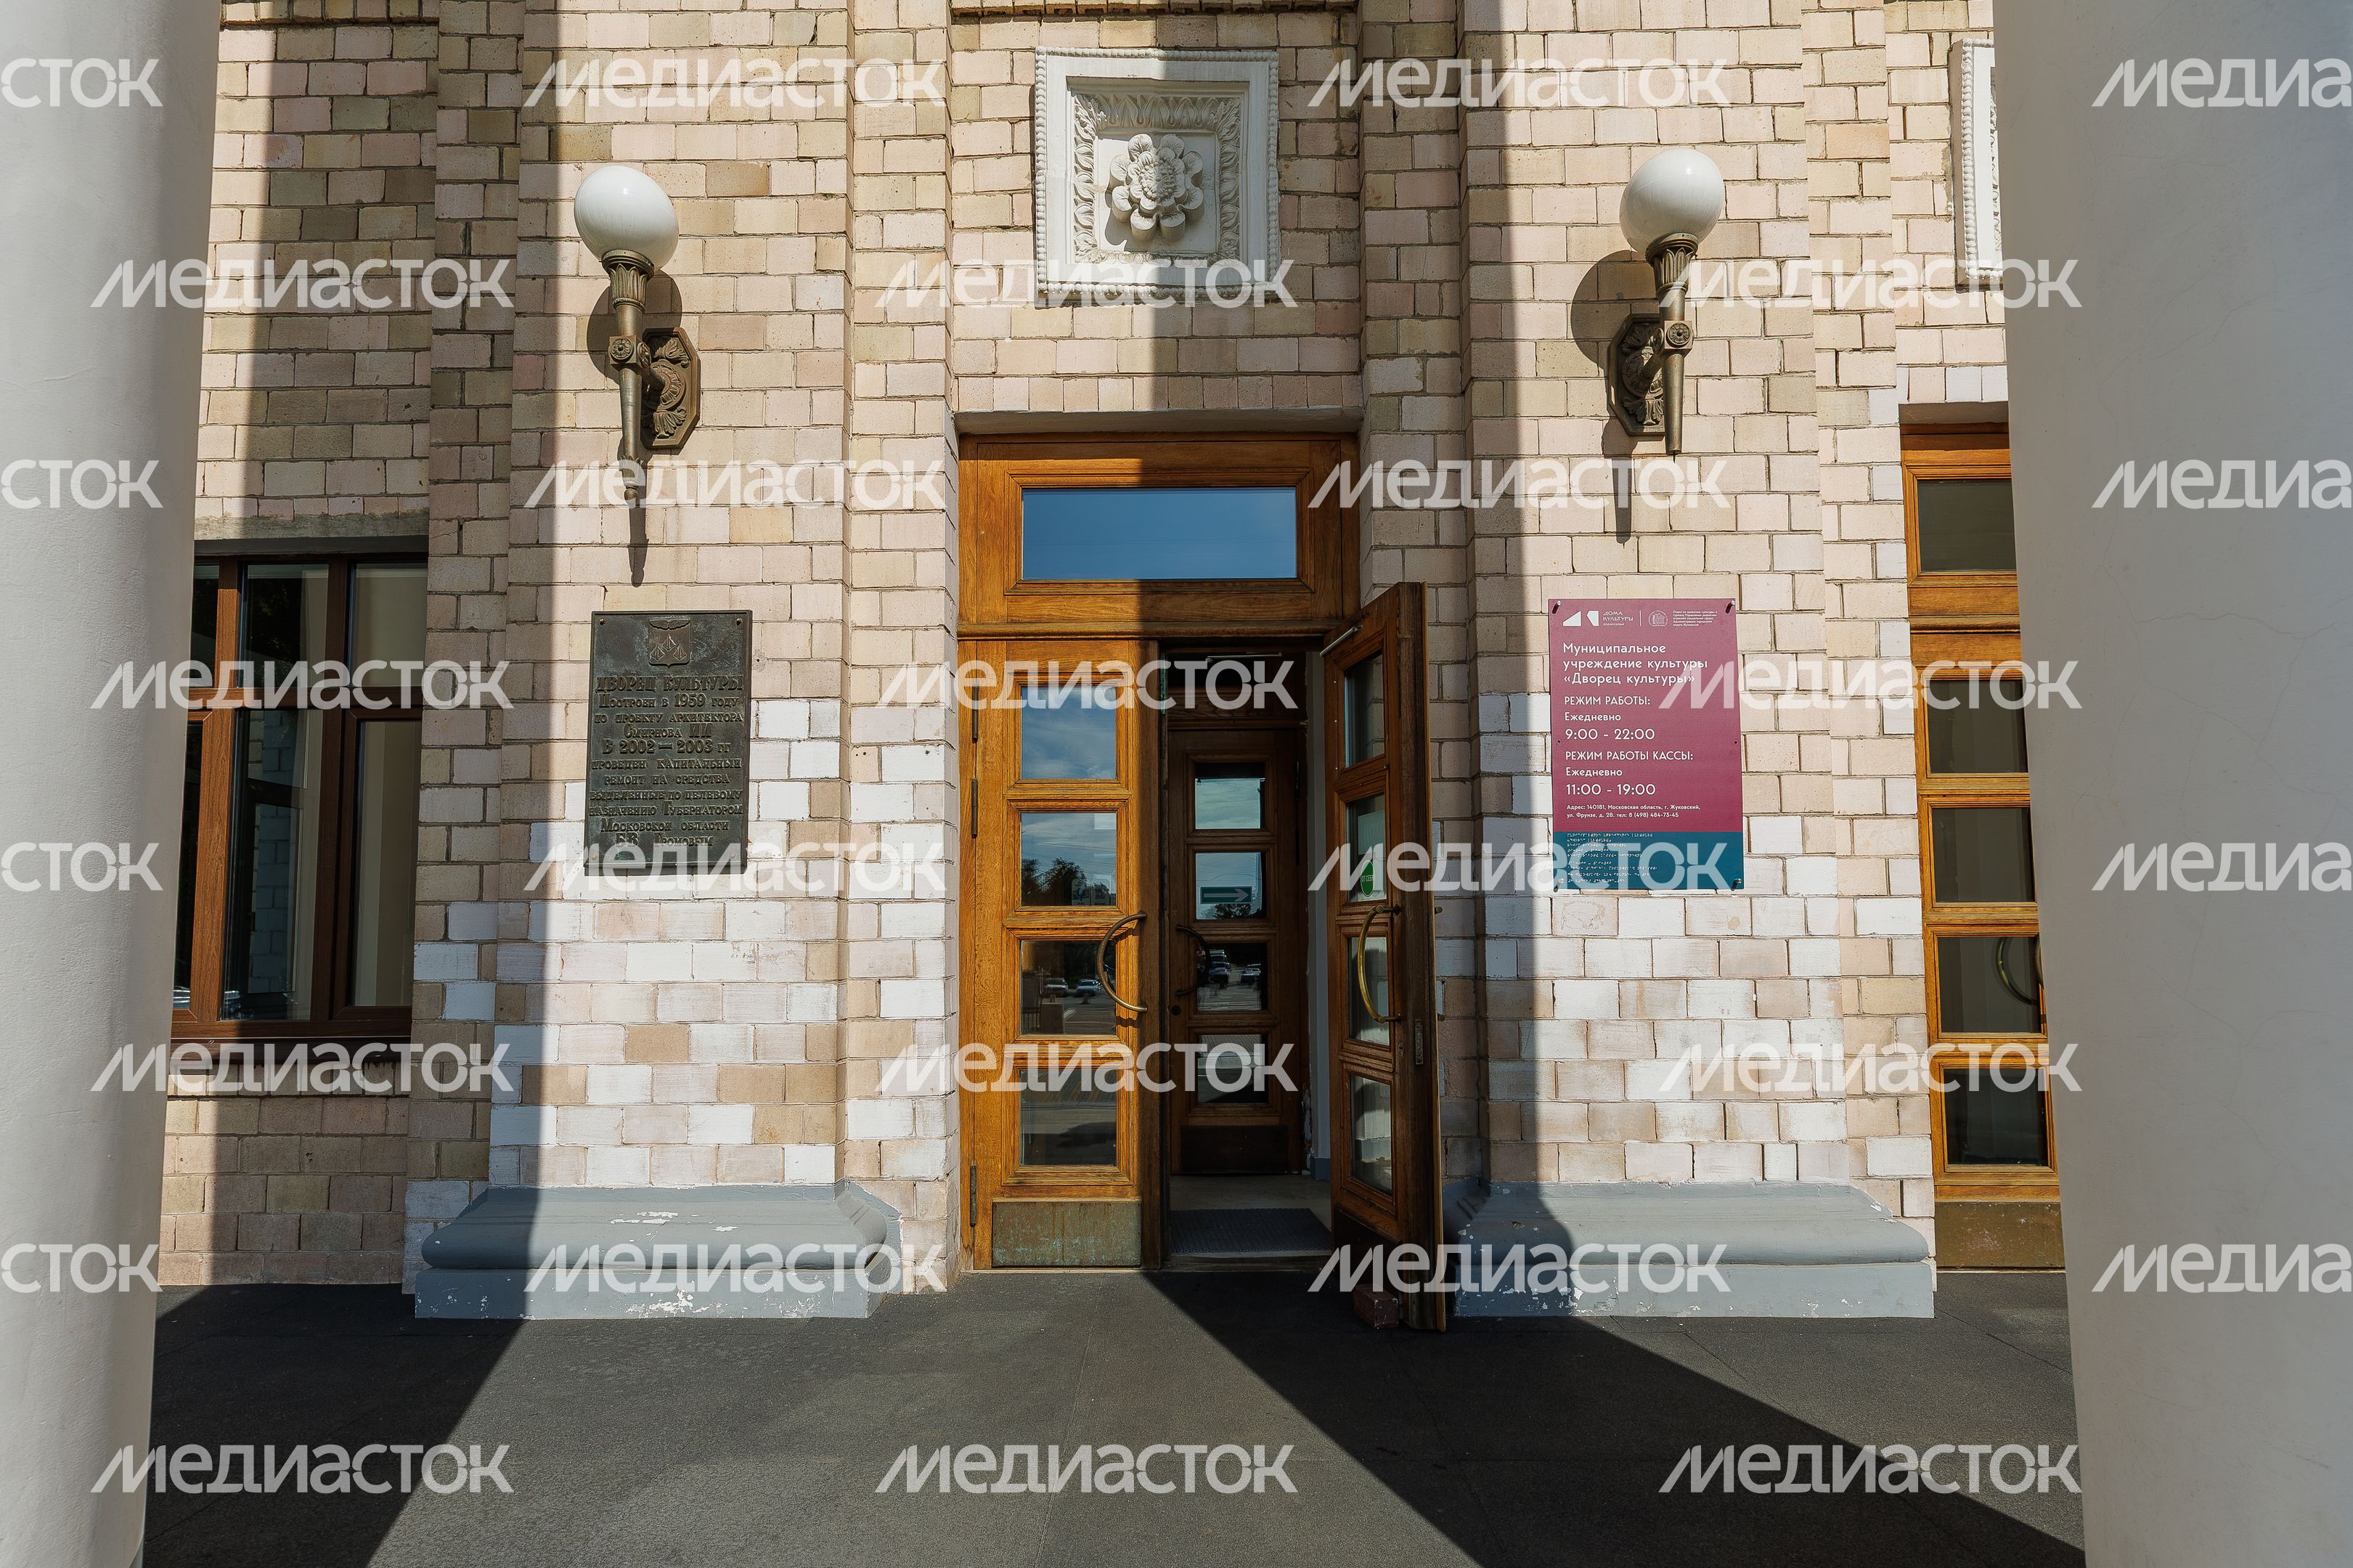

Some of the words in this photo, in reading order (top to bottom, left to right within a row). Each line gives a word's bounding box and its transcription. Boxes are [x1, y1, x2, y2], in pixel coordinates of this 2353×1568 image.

[1563, 642, 1666, 656] Муниципальное
[1563, 660, 1642, 671] учреждение
[1647, 660, 1708, 671] культуры
[595, 675, 657, 693] ДВОРЕЦ
[663, 675, 743, 690] КУЛЬТУРЫ
[1564, 672, 1621, 686] «Дворец
[1626, 676, 1695, 686] культуры»
[674, 693, 706, 708] 1959
[1565, 695, 1602, 705] РЕЖИМ
[1605, 695, 1650, 705] РАБОТЫ:
[615, 713, 664, 723] ПРОЕКТУ
[669, 712, 743, 722] АРХИТЕКТОРА
[1565, 712, 1621, 722] Ежедневно
[1565, 728, 1598, 740] 9:00
[1614, 728, 1655, 740] 22:00
[1566, 751, 1602, 760] РЕЖИМ
[1607, 751, 1649, 760] РАБОТЫ
[1652, 751, 1693, 760] КАССЫ:
[591, 759, 646, 770] ПРОВЕДЕН
[1566, 767, 1623, 777] Ежедневно
[604, 775, 645, 785] РЕМОНТ
[652, 775, 668, 785] НА
[675, 774, 730, 785] СРЕДСТВА
[1566, 783, 1602, 795] 11:00
[1617, 783, 1655, 795] 19:00
[681, 821, 730, 831] ОБЛАСТИ
